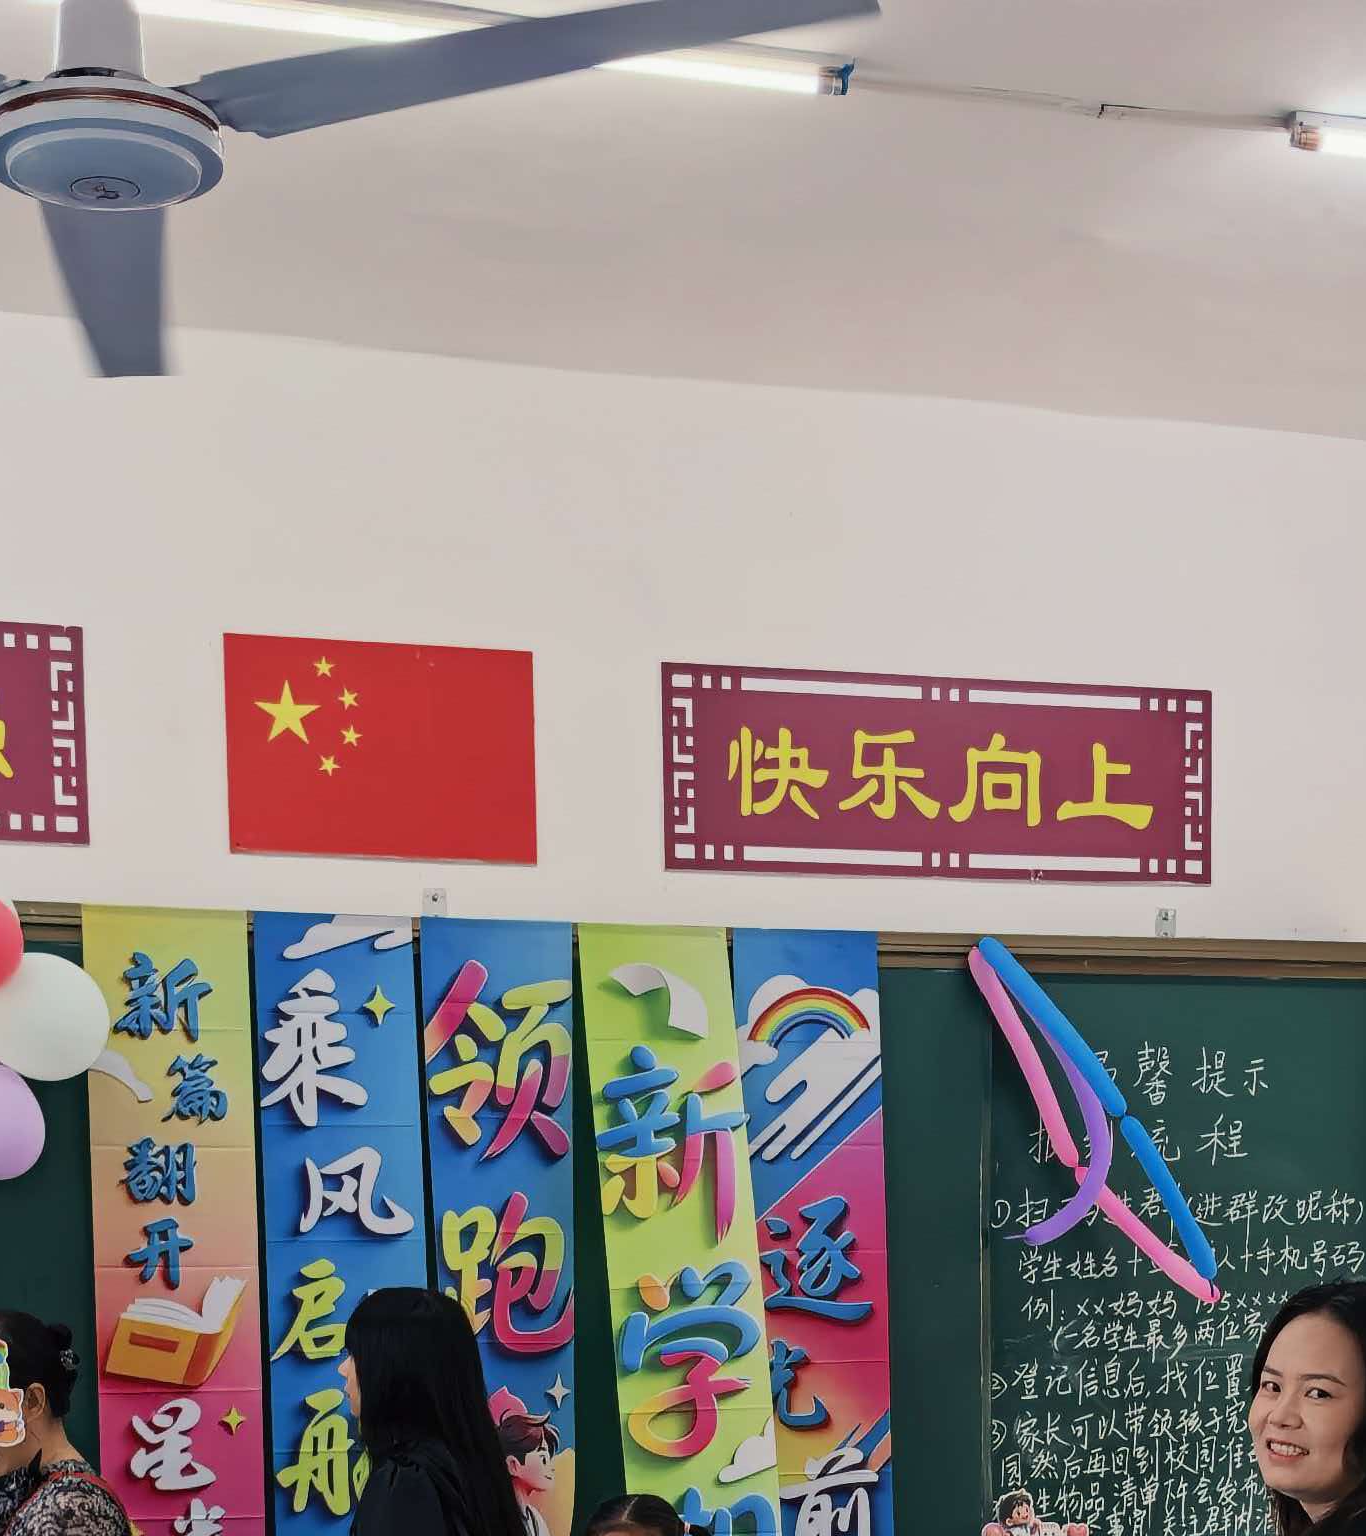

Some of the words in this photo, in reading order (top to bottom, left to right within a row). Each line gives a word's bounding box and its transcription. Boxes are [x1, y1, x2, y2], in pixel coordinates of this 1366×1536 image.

[728, 725, 1154, 831] 快乐向上
[112, 950, 228, 1290] 新篇翻开
[423, 957, 576, 1355] 领跑
